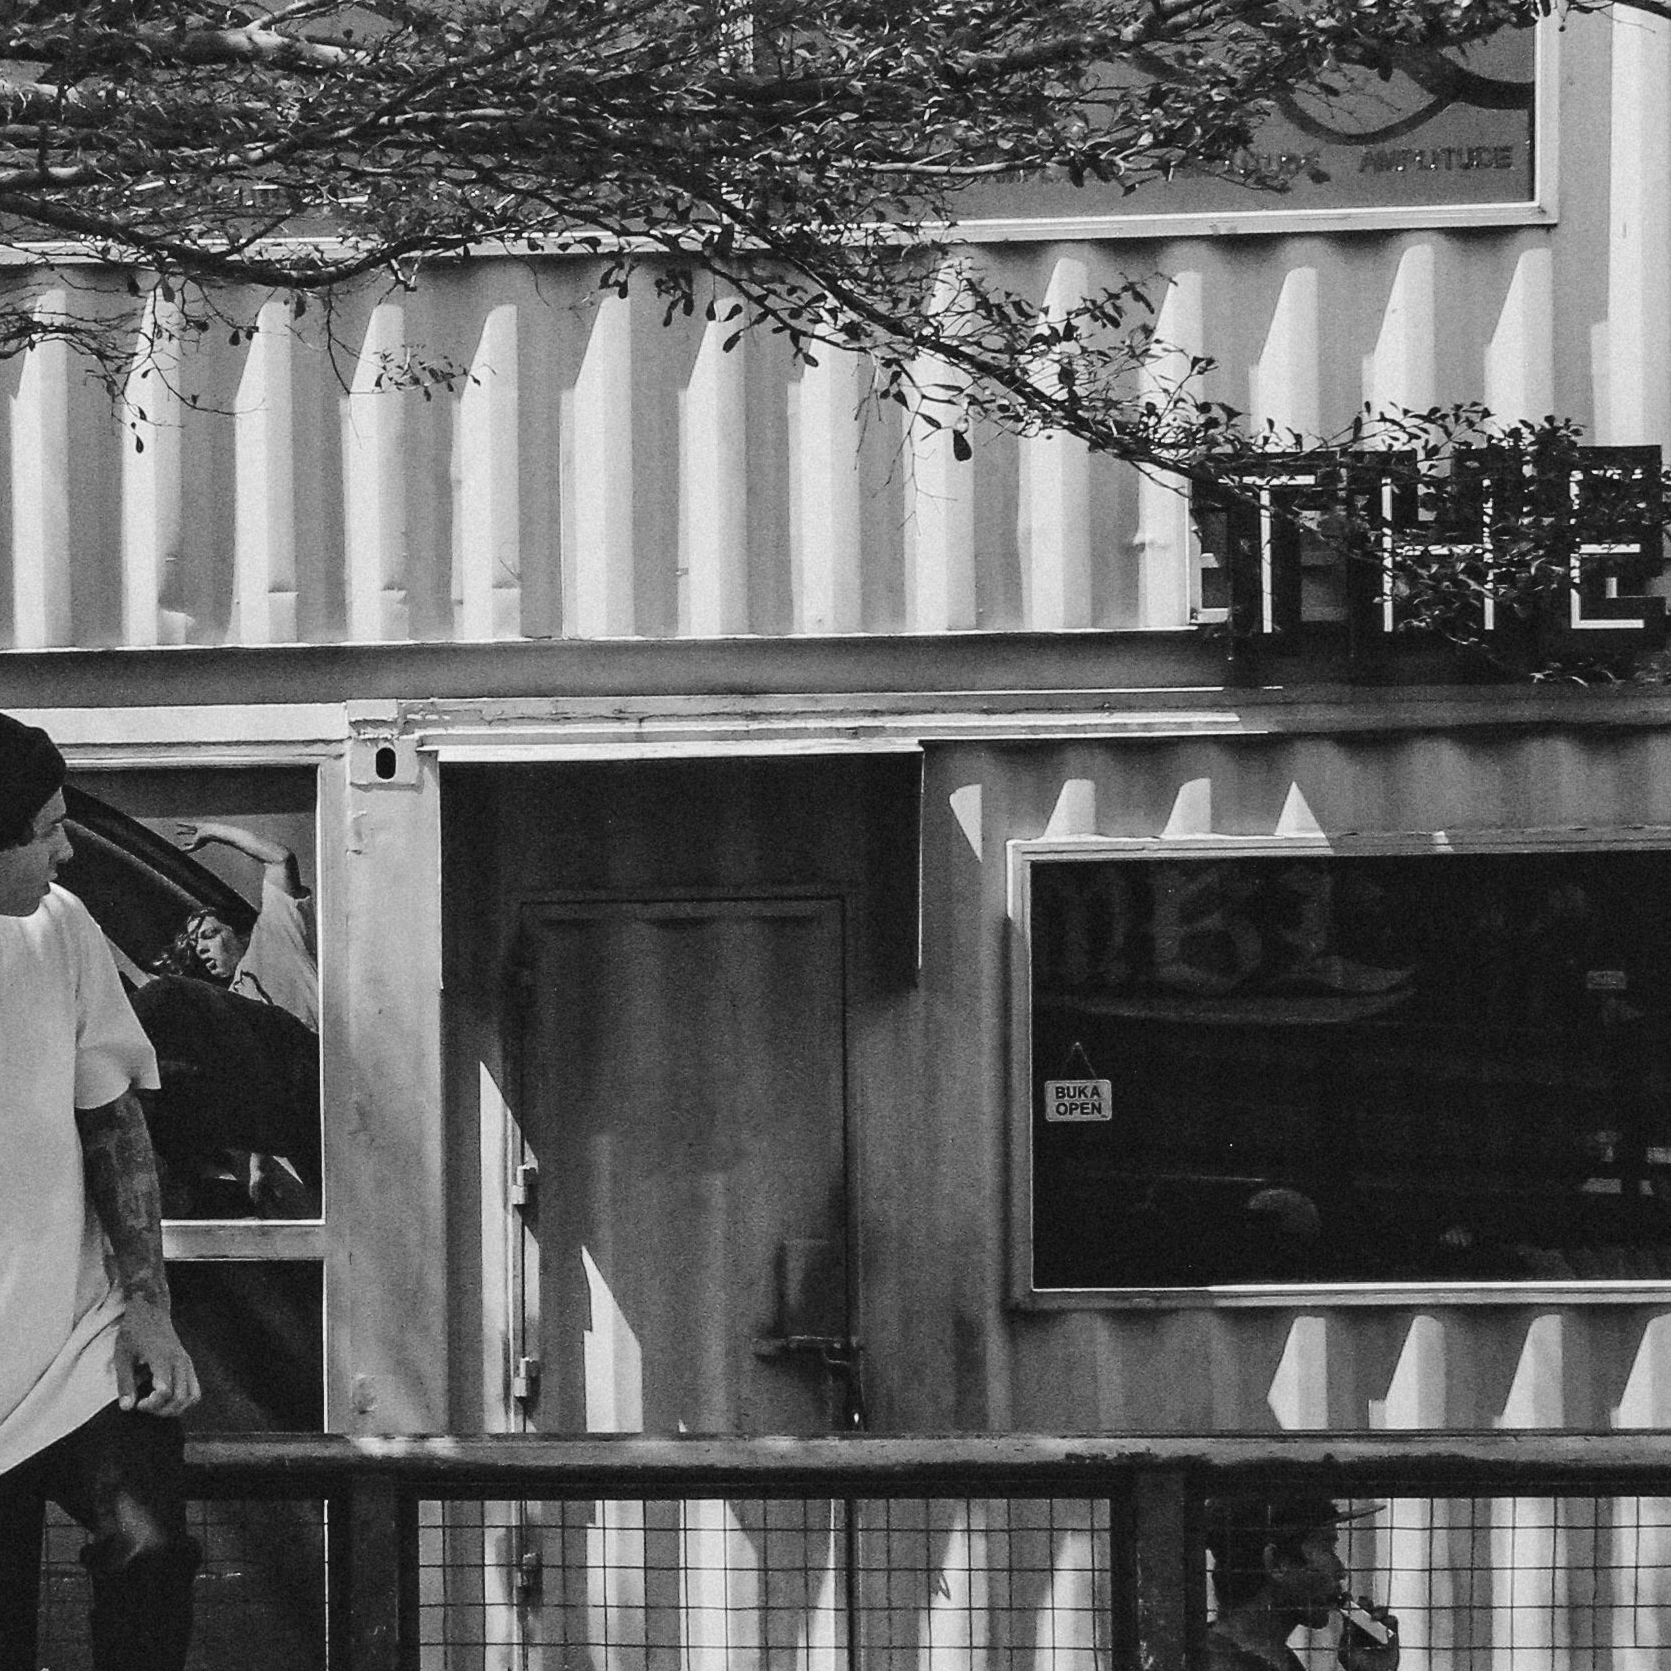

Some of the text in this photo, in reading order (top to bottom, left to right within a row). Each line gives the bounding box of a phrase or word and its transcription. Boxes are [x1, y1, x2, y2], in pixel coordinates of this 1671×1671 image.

[1213, 461, 1651, 635] THE
[1055, 1085, 1101, 1100] BUKA
[1055, 1102, 1102, 1116] OPEN
